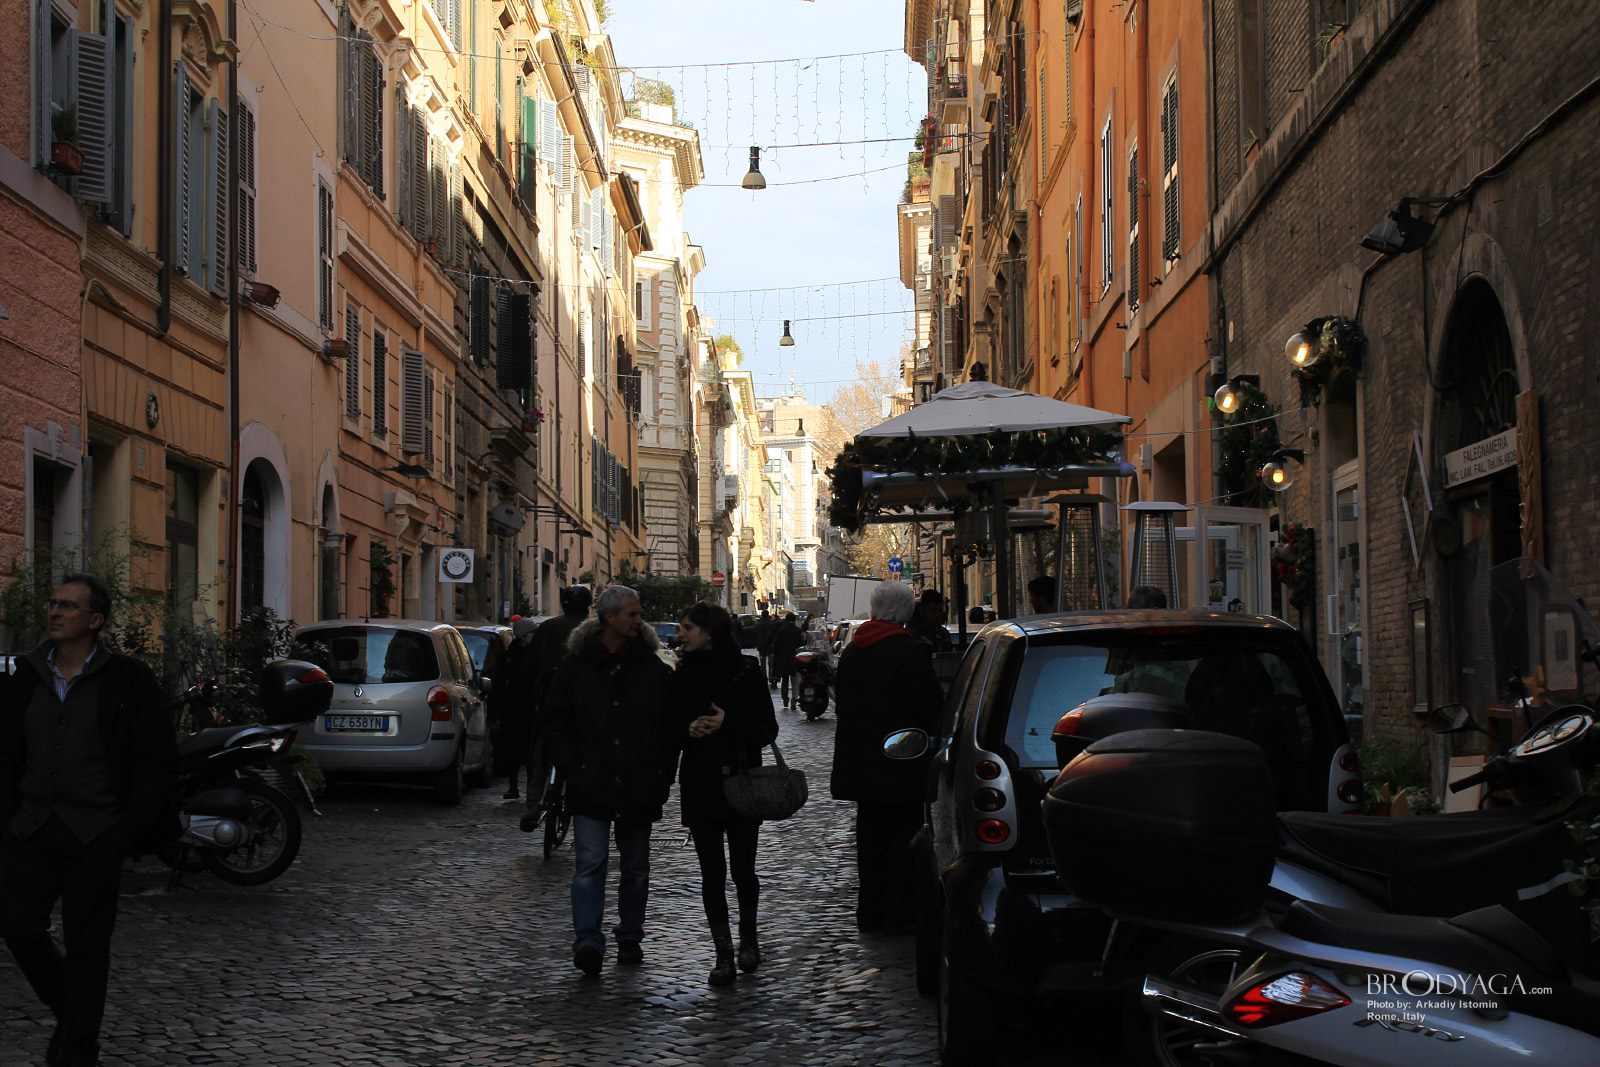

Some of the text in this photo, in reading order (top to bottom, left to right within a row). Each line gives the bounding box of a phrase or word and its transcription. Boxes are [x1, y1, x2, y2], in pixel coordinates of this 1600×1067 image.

[1463, 435, 1508, 464] FALEGNAMERIA
[333, 717, 345, 728] CZ
[1029, 857, 1055, 866] fort
